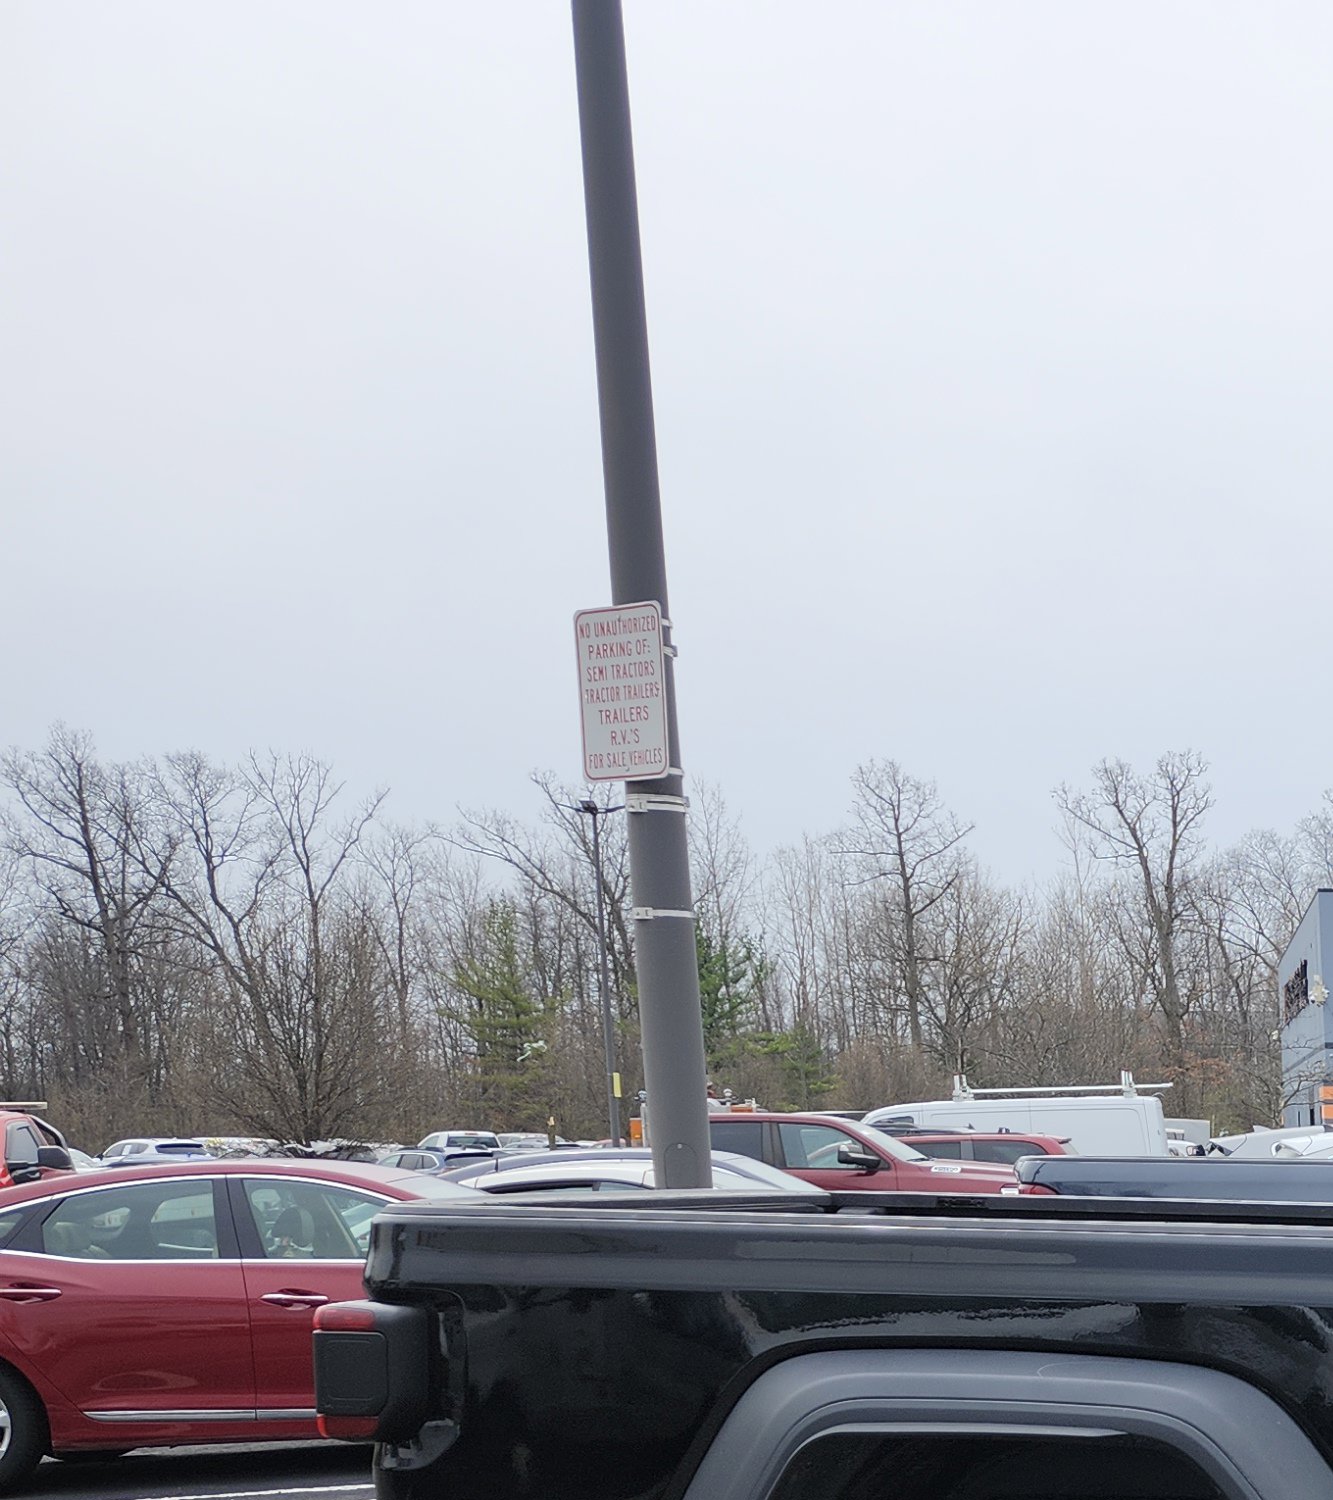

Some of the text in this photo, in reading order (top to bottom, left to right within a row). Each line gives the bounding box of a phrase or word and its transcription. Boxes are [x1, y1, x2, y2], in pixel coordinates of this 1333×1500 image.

[579, 615, 656, 639] NO UNAUTHORIZED
[588, 641, 632, 660] PARKING
[587, 660, 655, 682] SEMI TRACTORS
[585, 681, 660, 704] TRACTOR TRAILERS
[599, 705, 649, 725] TRAILERS
[589, 748, 663, 769] FOR SALE VEHICLES
